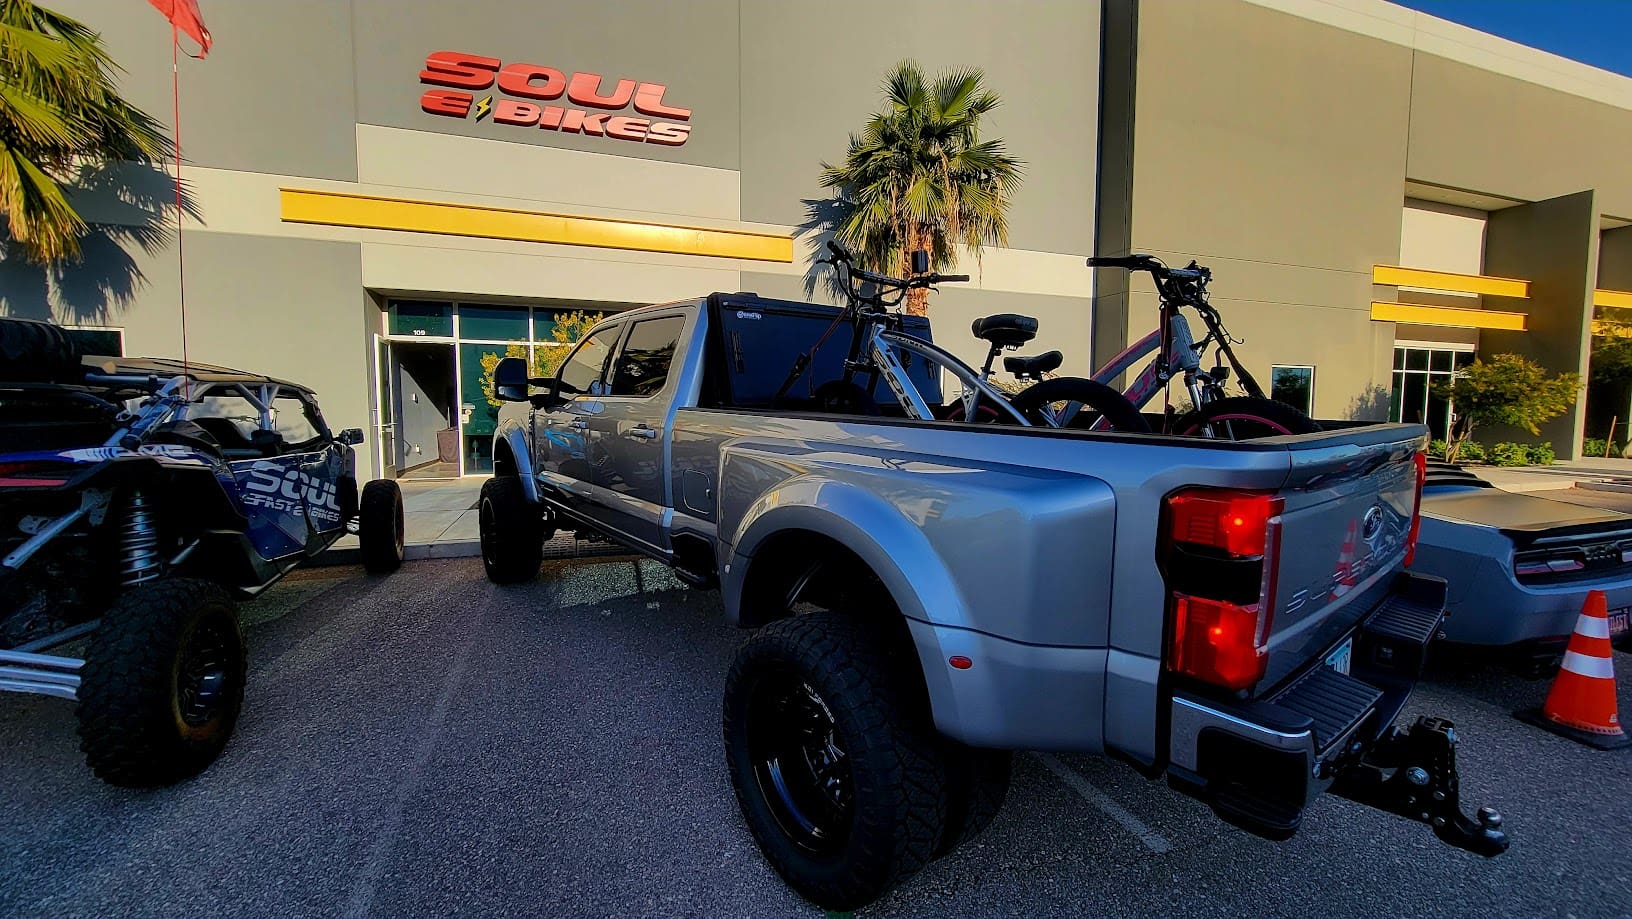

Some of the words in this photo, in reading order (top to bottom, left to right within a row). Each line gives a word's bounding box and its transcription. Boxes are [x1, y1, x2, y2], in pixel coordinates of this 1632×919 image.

[419, 51, 692, 121] SOUL
[420, 89, 474, 119] E
[493, 98, 692, 146] BIKES
[246, 460, 341, 511] SOUL
